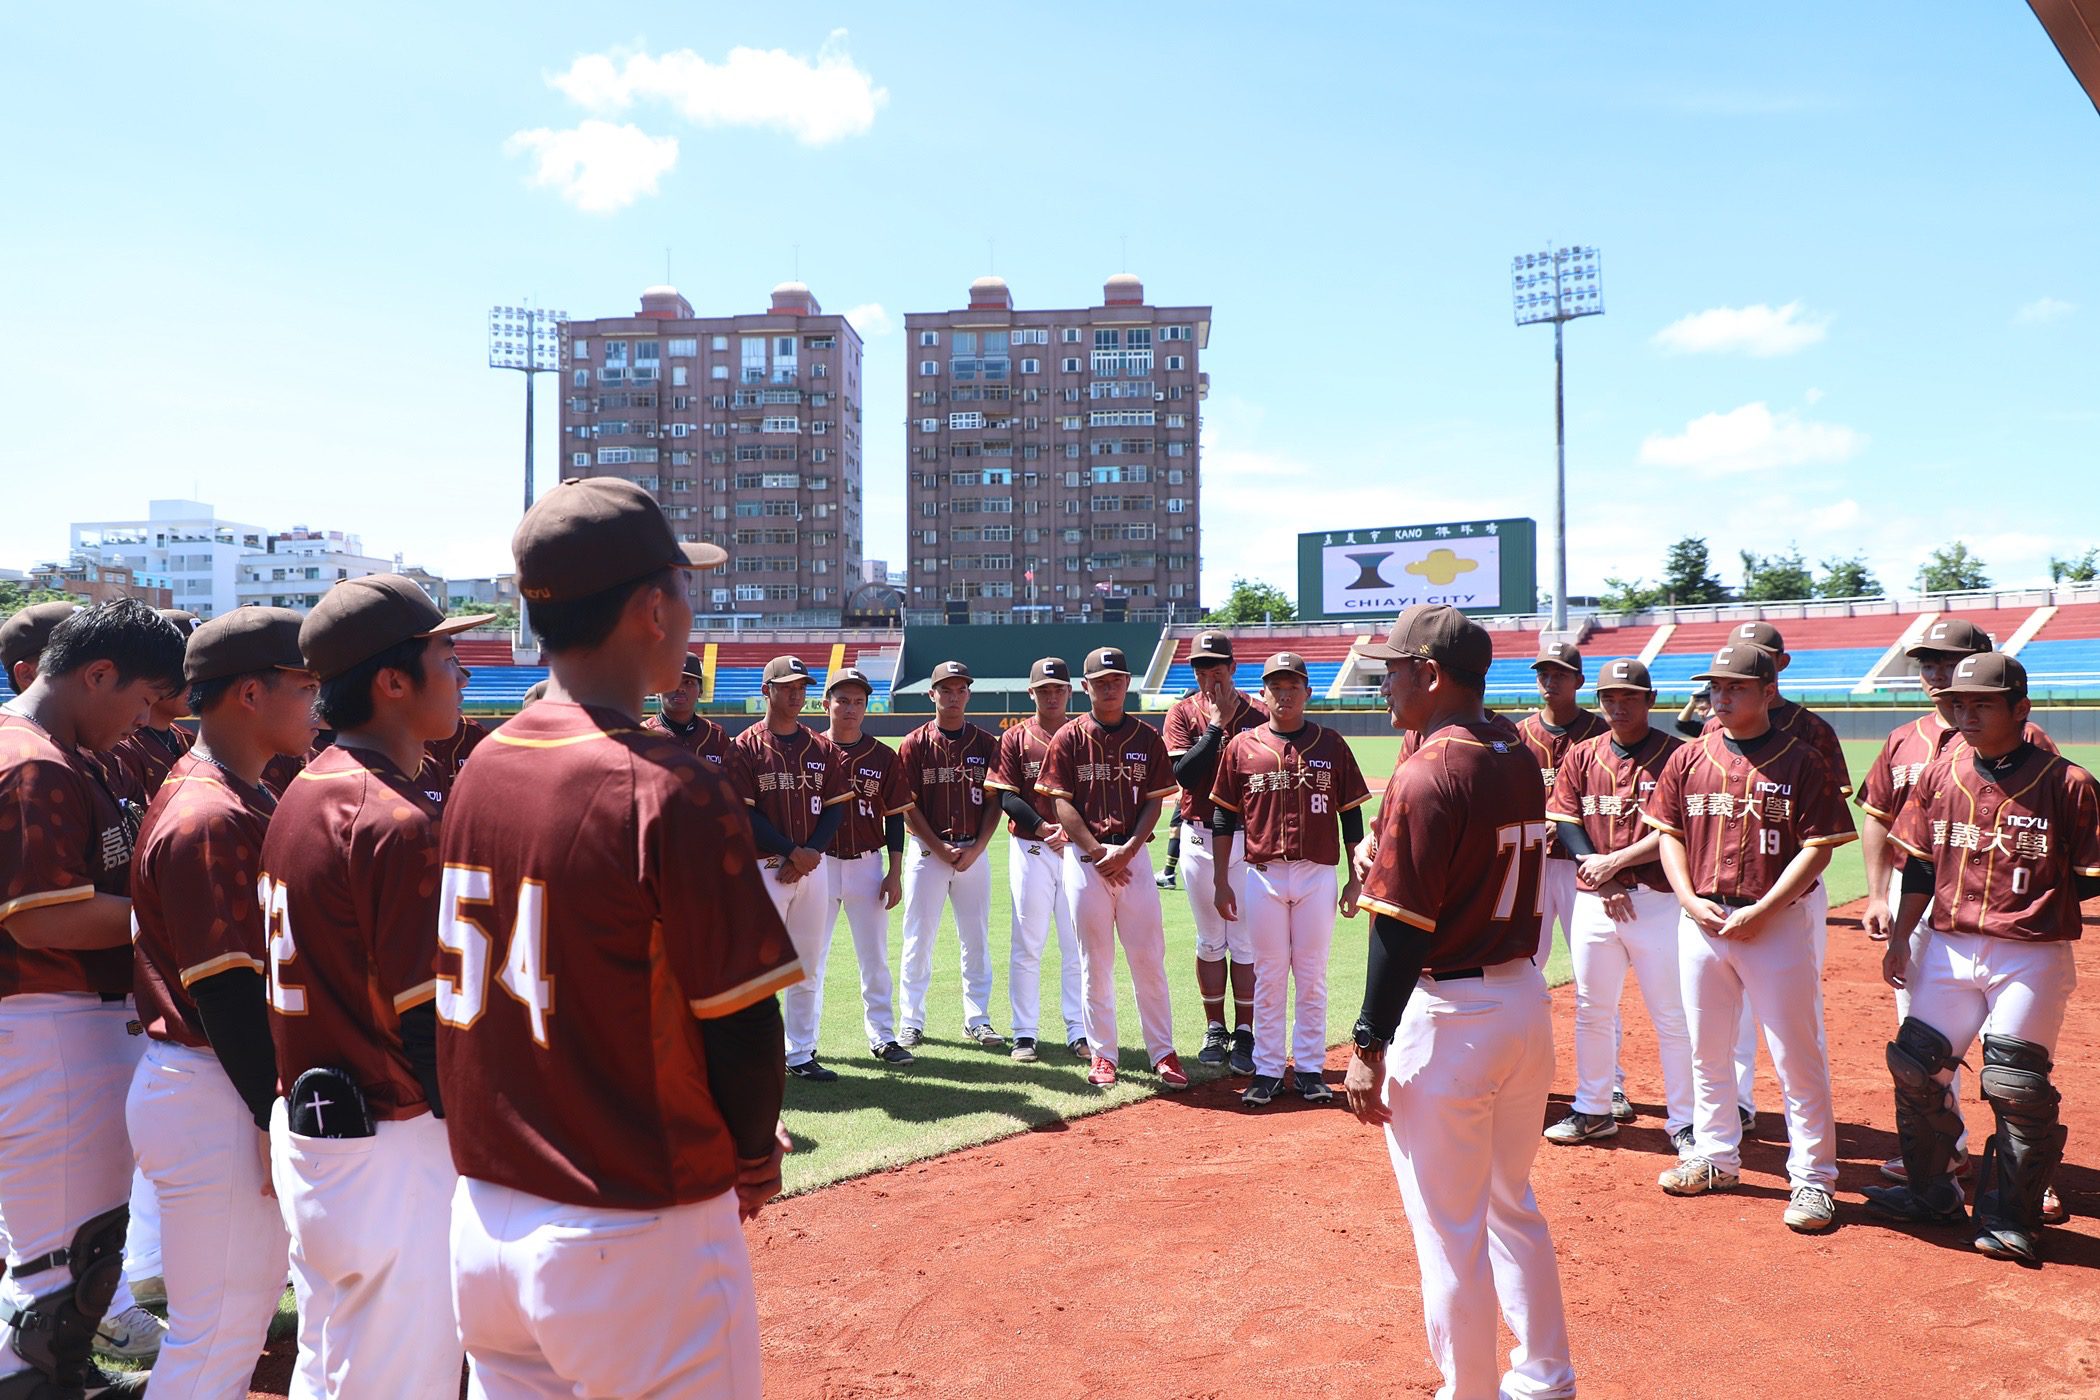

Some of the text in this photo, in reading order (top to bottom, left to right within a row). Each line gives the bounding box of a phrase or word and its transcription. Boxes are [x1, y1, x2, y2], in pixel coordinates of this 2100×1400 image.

[1395, 528, 1423, 540] KANO
[1345, 594, 1476, 608] CHIAYI CITY
[1740, 623, 1755, 637] C
[1931, 624, 1948, 639] C
[1201, 636, 1213, 648] C
[1548, 643, 1562, 655] C
[788, 657, 801, 669] C
[1101, 652, 1113, 664] C
[1278, 653, 1290, 665] C
[1716, 648, 1733, 664] C
[848, 668, 859, 678] C
[947, 661, 959, 672] C
[1042, 662, 1055, 673] C
[1612, 663, 1629, 678] C
[1958, 659, 1977, 677] C
[922, 765, 985, 784] 嘉義大學
[1077, 762, 1147, 783] 嘉義大學
[1248, 769, 1332, 794] 嘉義大學
[1311, 794, 1329, 814] 86
[1684, 792, 1790, 823] 嘉義大學
[1759, 827, 1781, 855] 19
[1933, 819, 2048, 860] 嘉義大學
[1491, 819, 1546, 921] 77
[435, 861, 556, 1050] 54
